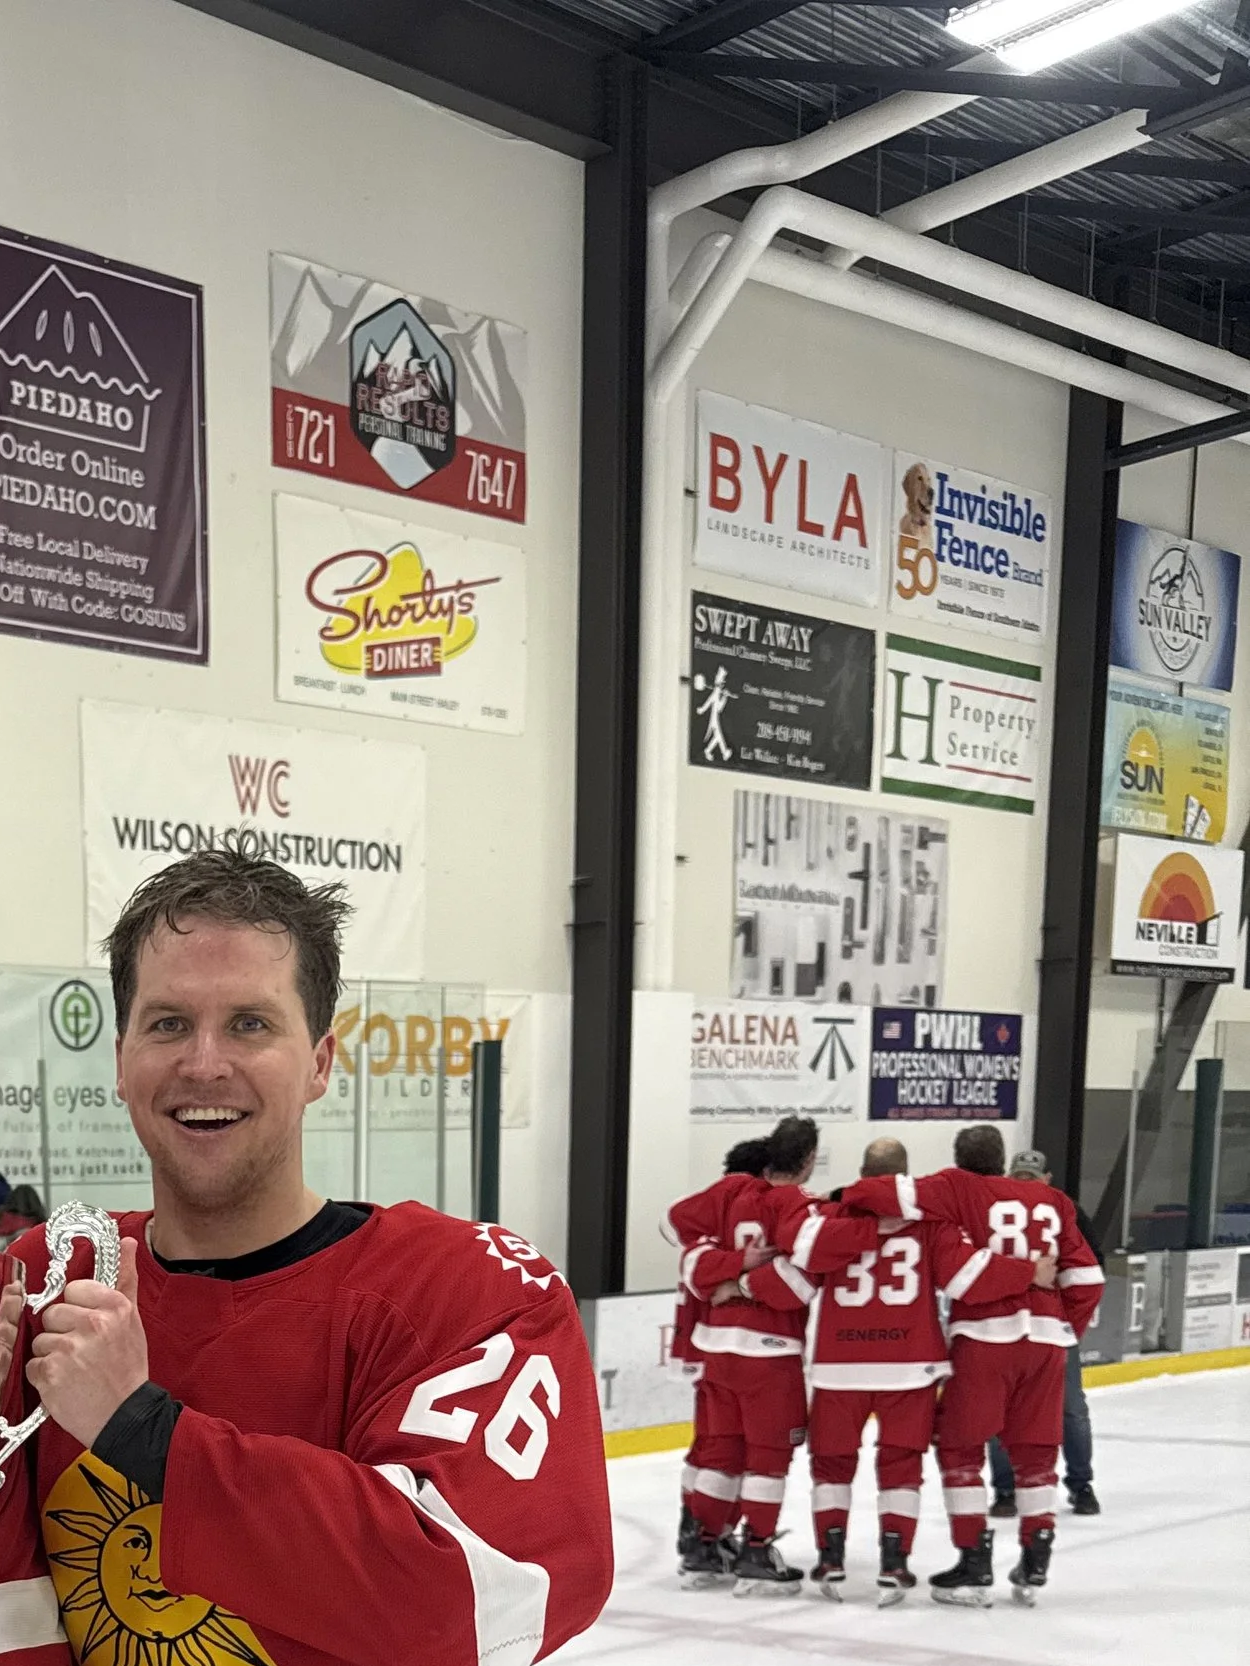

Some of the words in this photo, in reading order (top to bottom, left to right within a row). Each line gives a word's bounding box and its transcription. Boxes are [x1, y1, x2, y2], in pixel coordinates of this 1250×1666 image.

[9, 379, 134, 432] PIEDAHO
[294, 404, 336, 468] 721
[71, 449, 146, 489] Online
[464, 450, 518, 511] 7647
[708, 431, 870, 550] BYLA
[935, 470, 1047, 544] Invisible
[36, 532, 80, 558] Local
[82, 541, 149, 575] Delivery
[707, 516, 785, 550] LANDSCAPE
[789, 540, 872, 572] ARCHITECTS
[894, 532, 940, 601] 50
[934, 519, 1011, 578] Fence
[1011, 560, 1045, 588] Brand
[29, 586, 70, 612] With
[70, 596, 119, 621] Code:
[120, 604, 188, 632] GOSUNS
[85, 569, 156, 603] Shipping
[305, 549, 503, 643] Shorty's
[693, 604, 761, 643] SWEPT
[760, 620, 814, 654] AWAY
[1138, 598, 1163, 630] SUN
[1163, 606, 1213, 643] VALLEY
[372, 642, 435, 673] DINER
[886, 667, 945, 768] H
[949, 694, 1037, 738] Property
[946, 731, 1020, 767] Service
[1119, 759, 1165, 796] SUN
[112, 815, 215, 855] WILSON
[224, 826, 403, 874] CONSTRUCTION
[1135, 920, 1194, 946] NEVILLE
[913, 1011, 984, 1051] PWHL
[871, 1052, 963, 1079] PROFESSIONAL
[963, 1054, 1021, 1081] WOMEN'S
[52, 1084, 107, 1114] eyes
[897, 1079, 949, 1105] HOCKEY
[952, 1080, 999, 1106] LEAGUE
[988, 1200, 1062, 1262] 83
[834, 1236, 922, 1307] 33
[397, 1332, 561, 1481] 26
